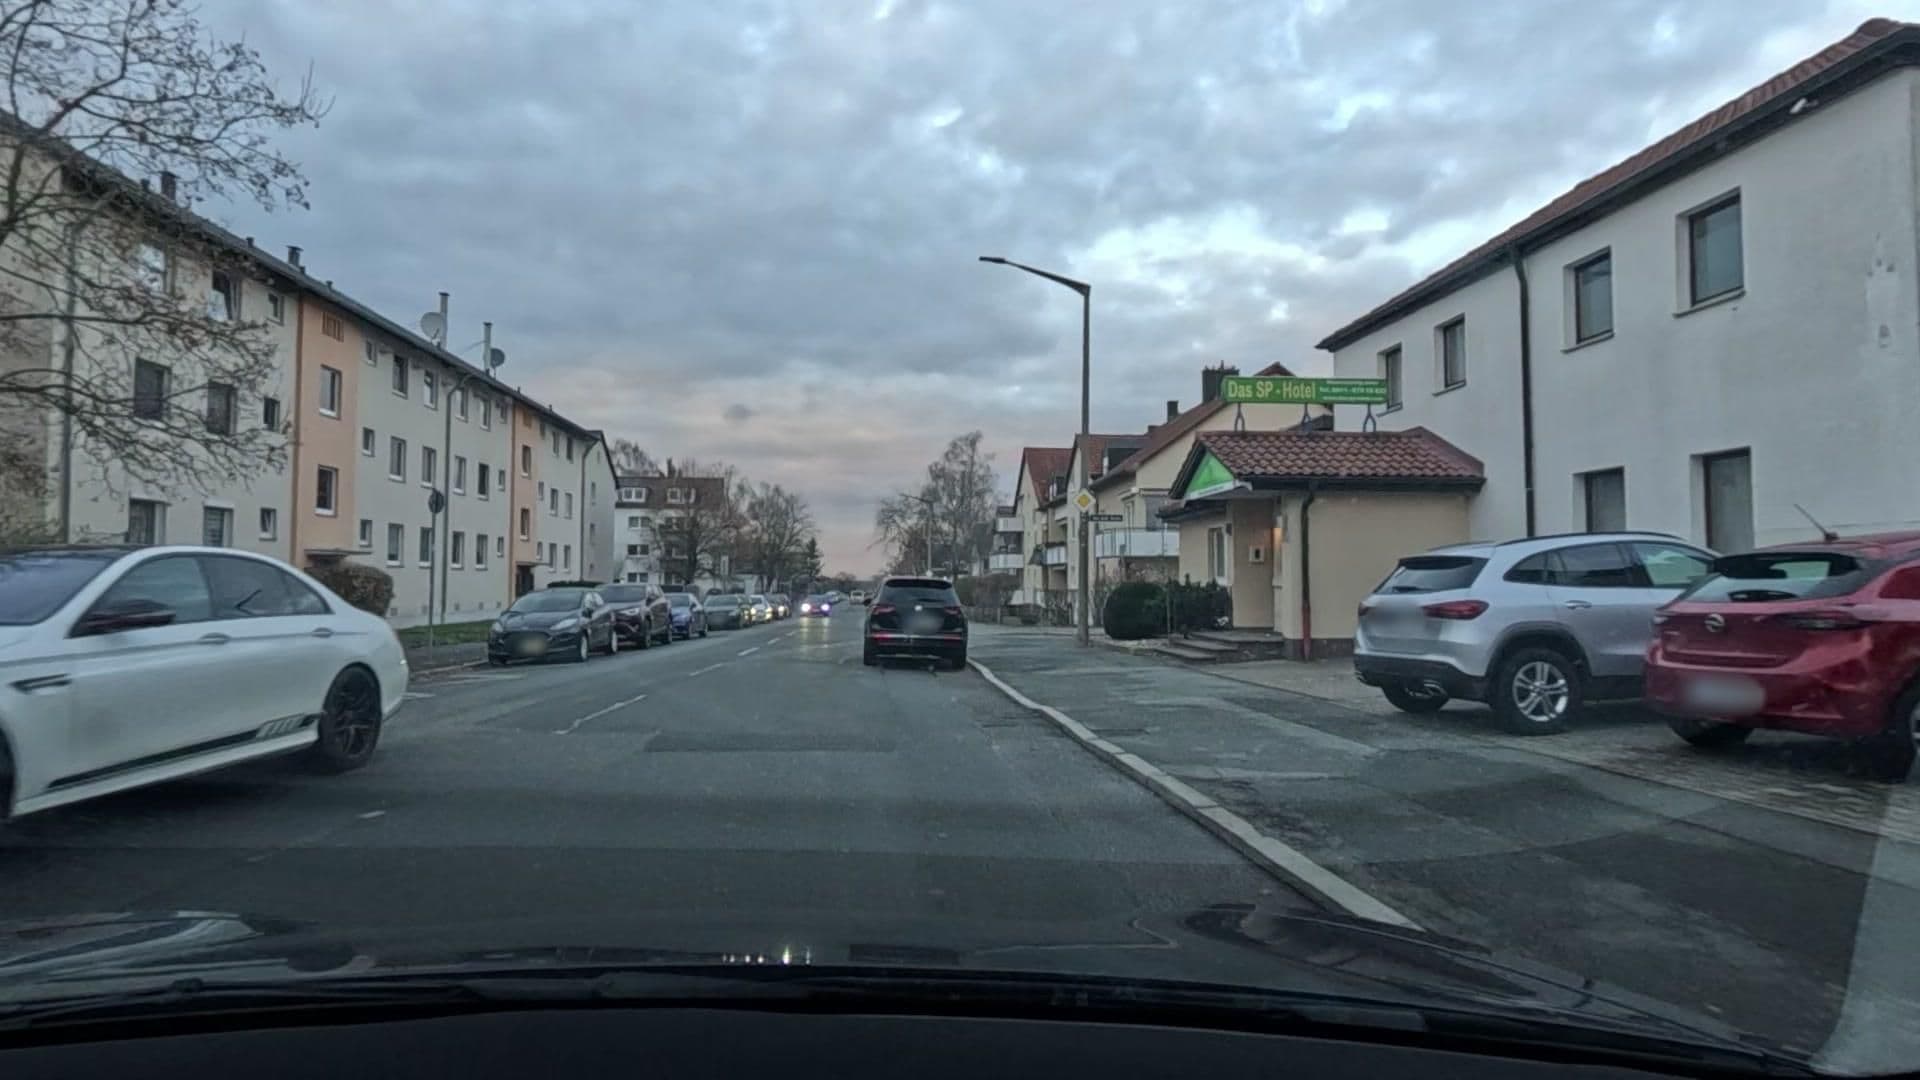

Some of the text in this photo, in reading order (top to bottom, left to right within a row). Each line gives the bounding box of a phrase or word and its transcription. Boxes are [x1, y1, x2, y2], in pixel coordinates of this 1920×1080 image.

[1228, 381, 1252, 398] Das
[1256, 381, 1273, 398] SP
[1282, 381, 1316, 399] Hotel
